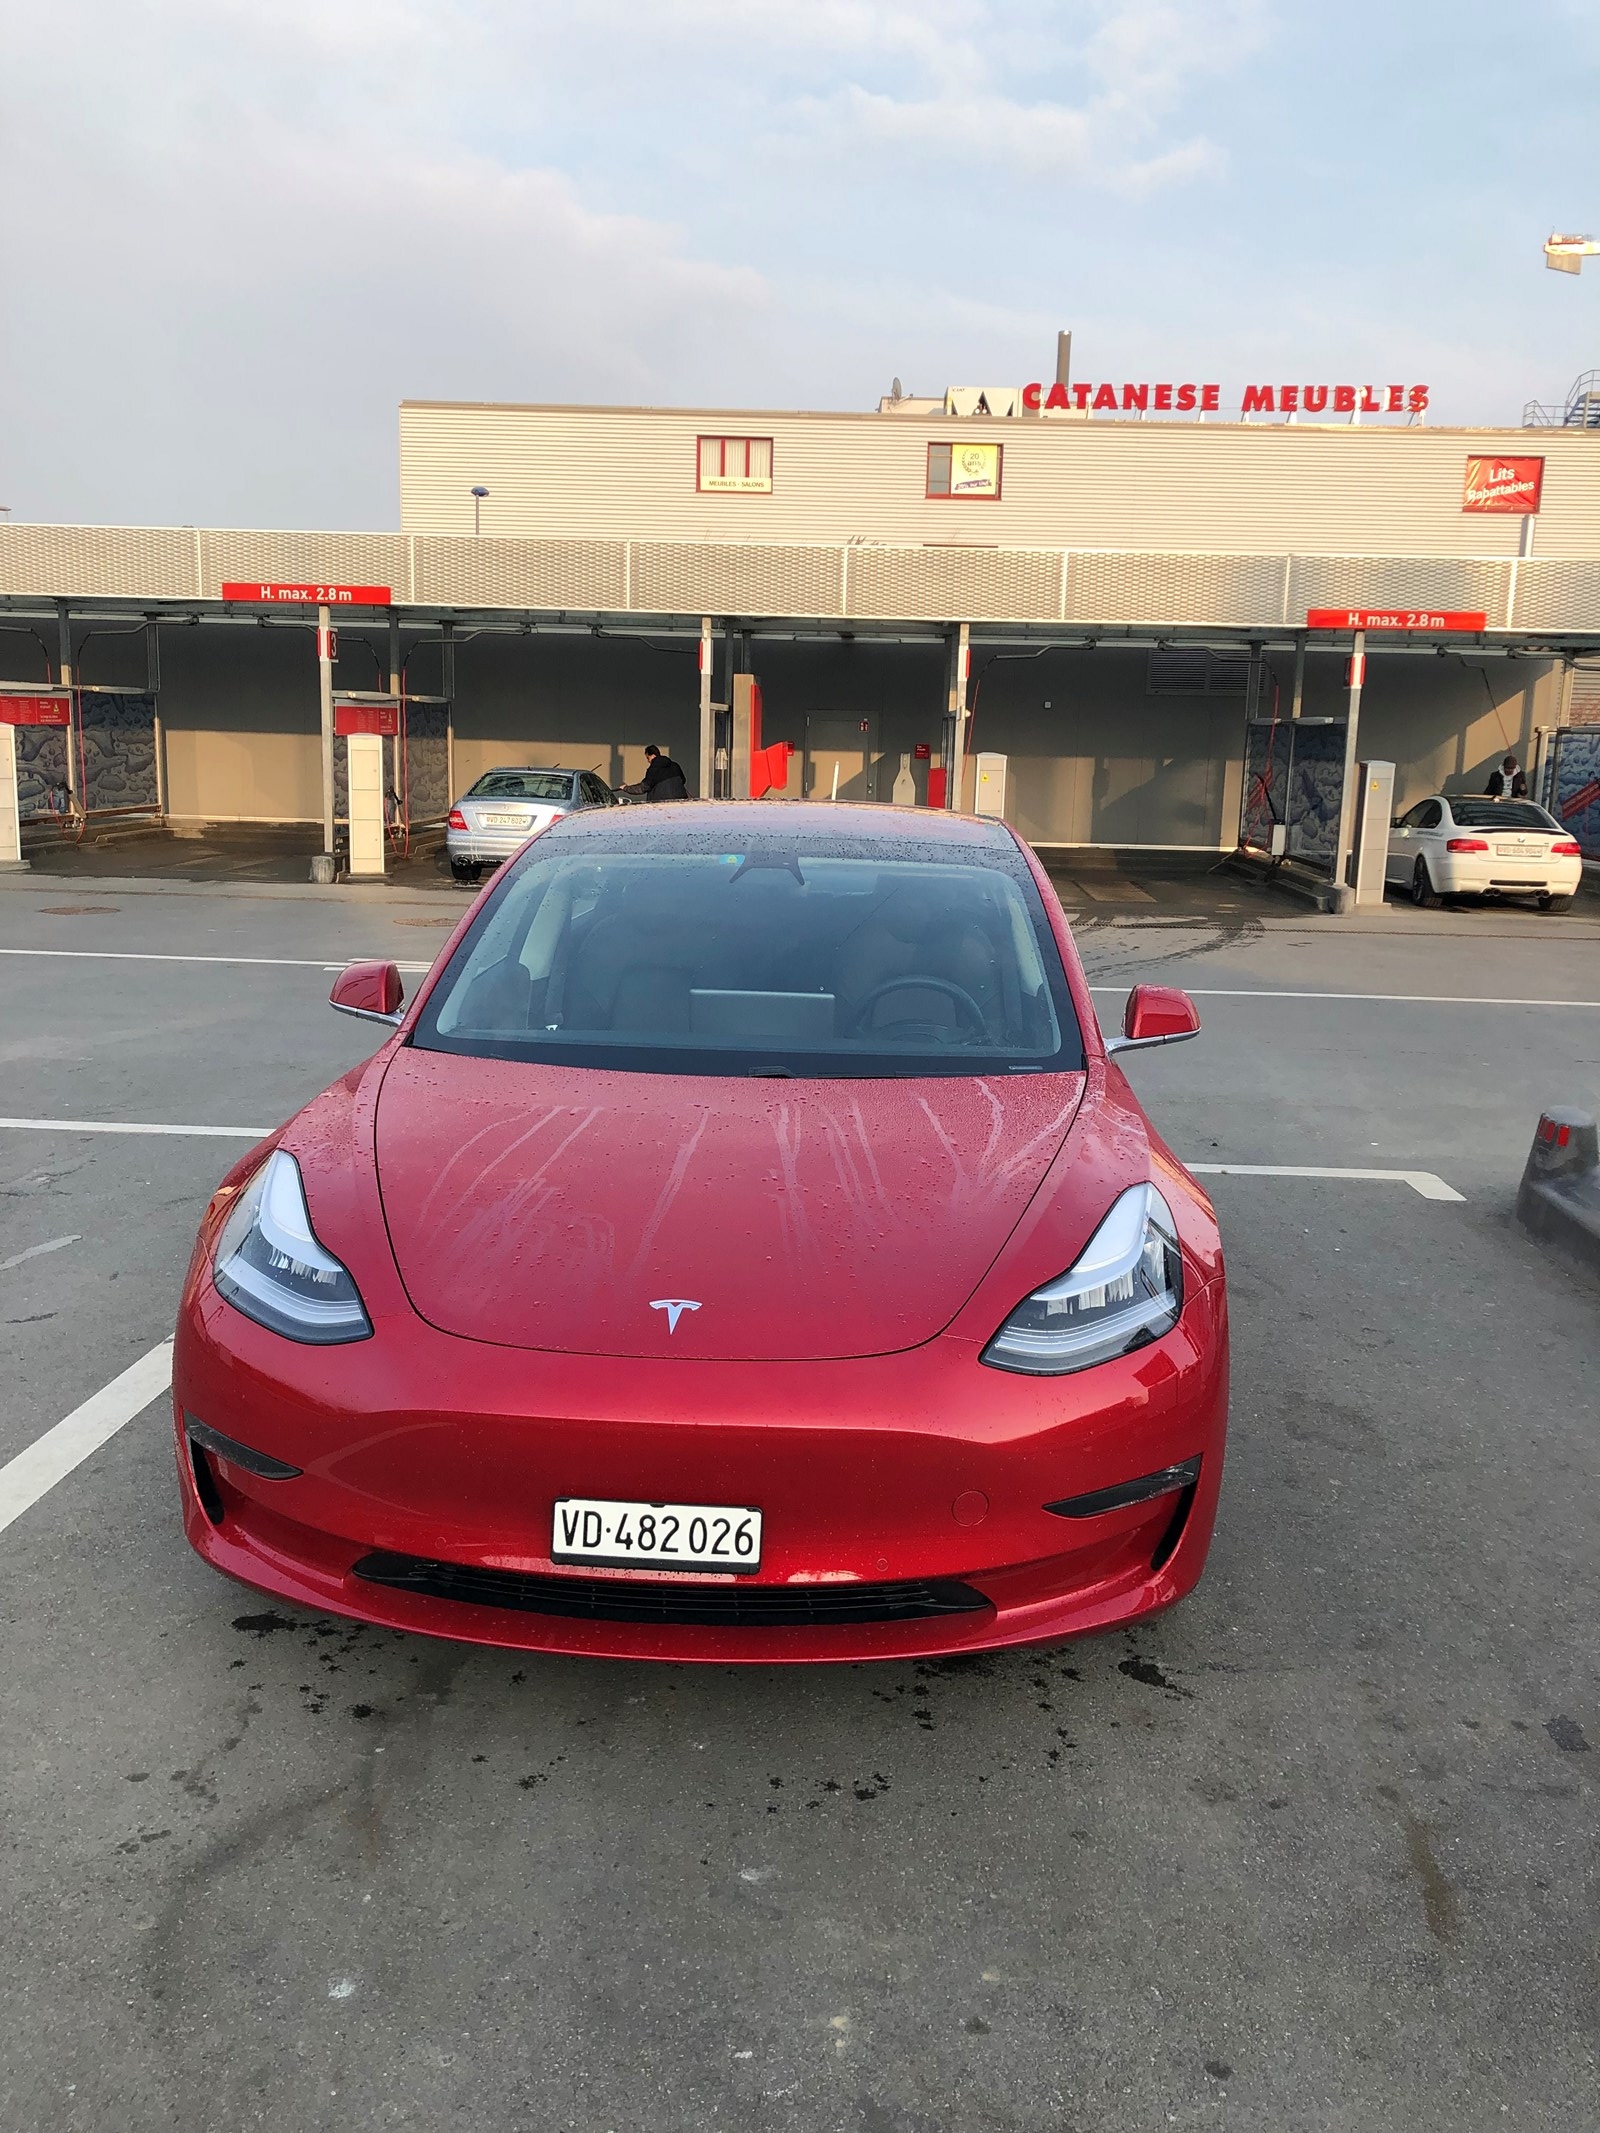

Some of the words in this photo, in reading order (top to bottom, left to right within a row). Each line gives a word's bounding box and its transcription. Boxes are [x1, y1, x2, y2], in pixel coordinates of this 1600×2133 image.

[1022, 383, 1221, 411] CATANESE
[1240, 384, 1430, 413] MEUBLES
[1489, 468, 1515, 483] Lits
[1467, 481, 1535, 502] Rabattables
[260, 585, 275, 599] H.
[278, 588, 313, 600] max.
[315, 586, 337, 601] 2.8
[338, 590, 353, 601] m
[1347, 612, 1363, 626] H.
[1366, 614, 1403, 627] max.
[1406, 613, 1429, 627] 2.8
[1430, 615, 1445, 628] m
[330, 633, 337, 657] 3
